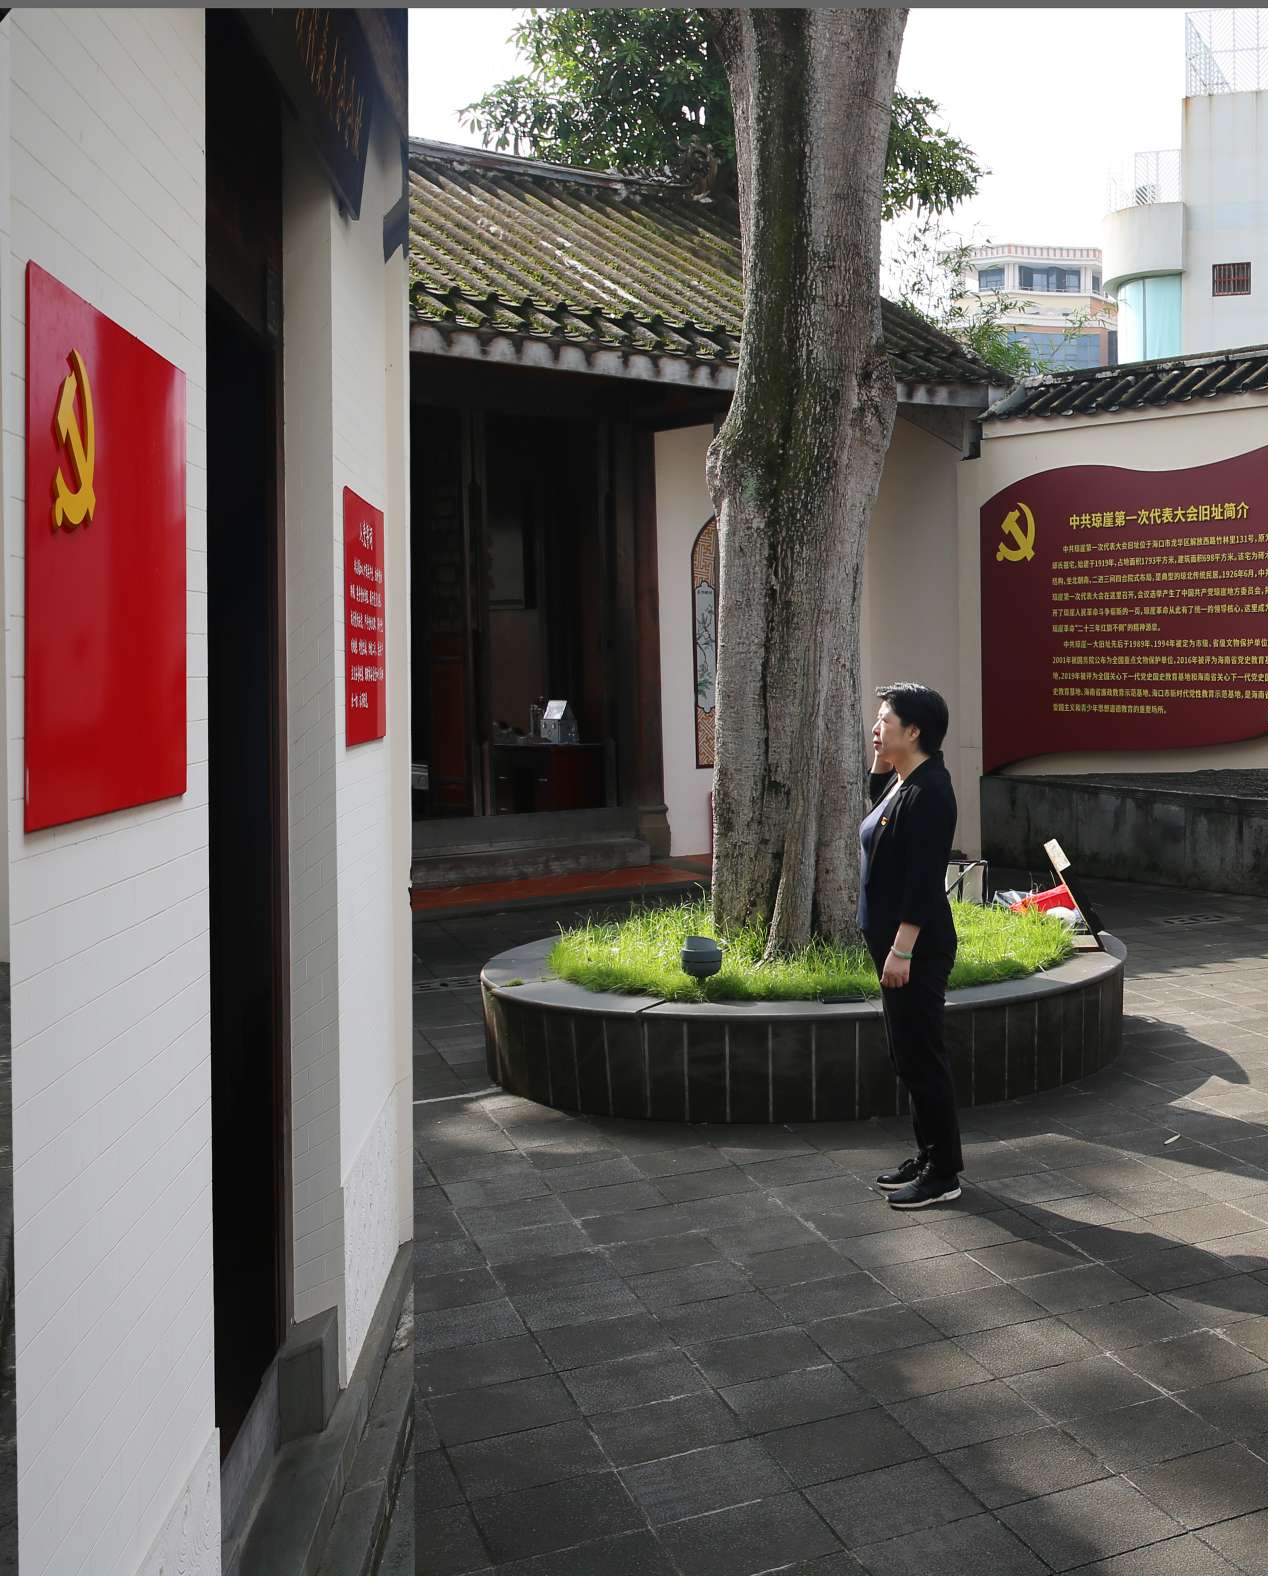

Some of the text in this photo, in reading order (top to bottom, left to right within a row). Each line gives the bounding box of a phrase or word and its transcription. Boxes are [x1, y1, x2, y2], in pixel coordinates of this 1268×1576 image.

[1069, 501, 1249, 529] 中共琼崖第一次代表大会旧址简介
